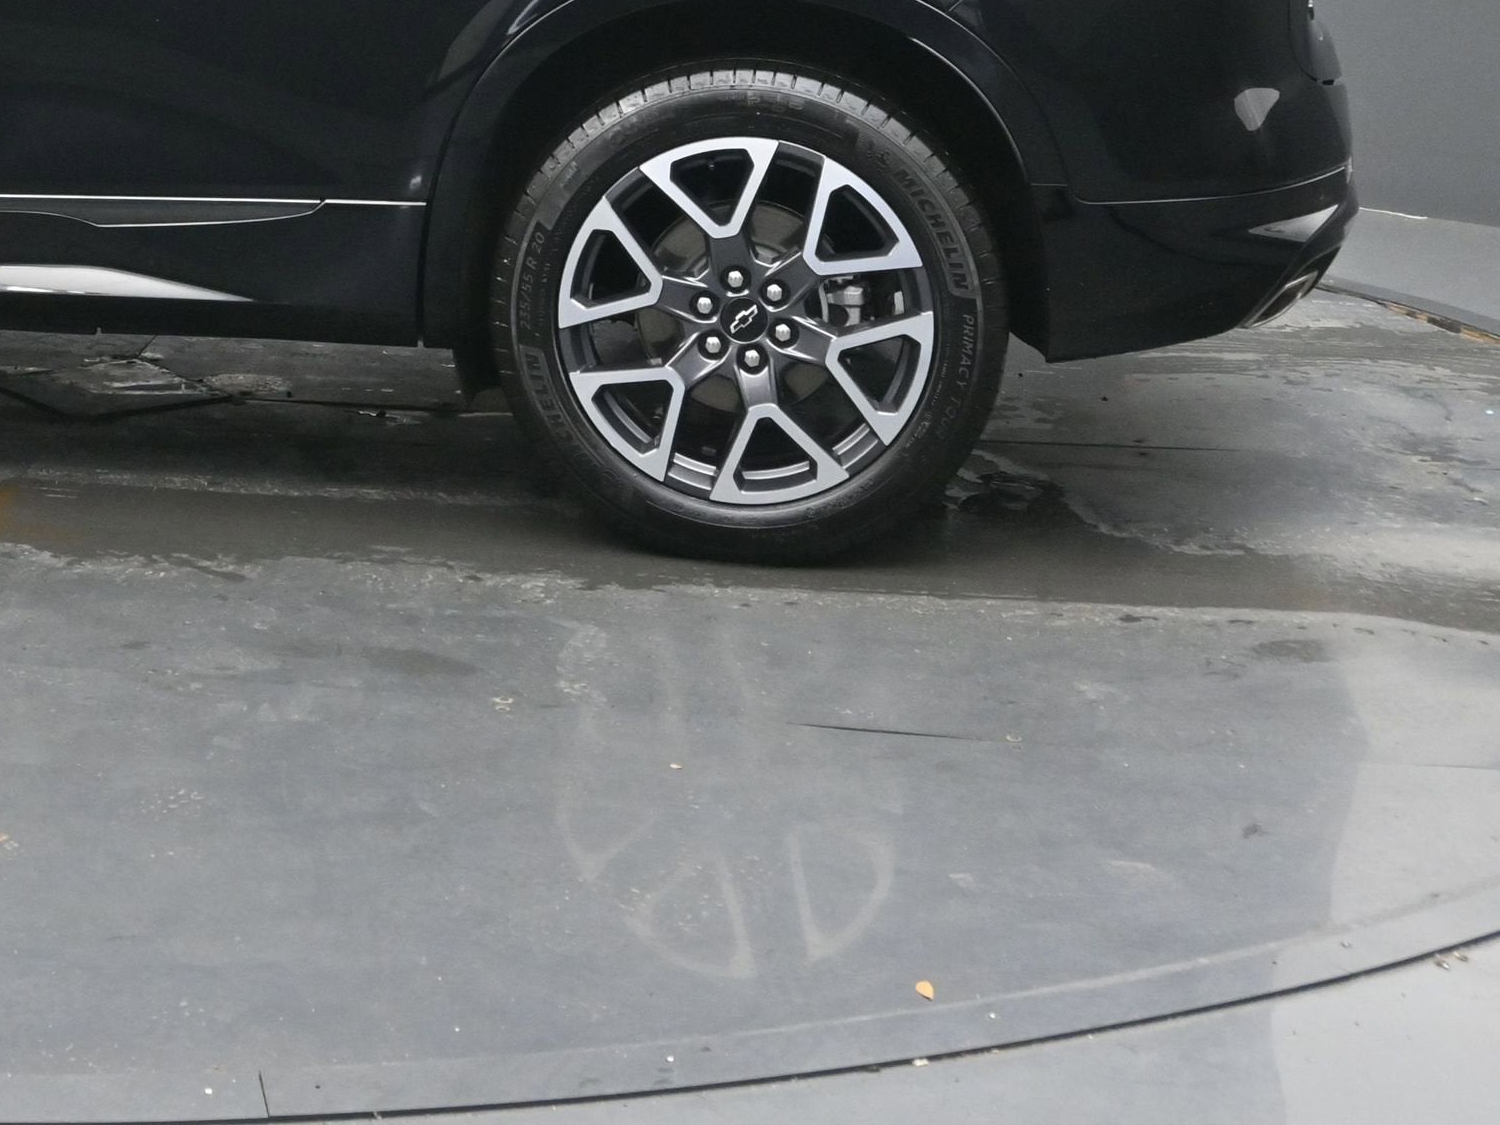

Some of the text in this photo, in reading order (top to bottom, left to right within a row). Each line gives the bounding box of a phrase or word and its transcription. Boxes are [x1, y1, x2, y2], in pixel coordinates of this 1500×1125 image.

[895, 169, 970, 290] MICHELIN
[520, 274, 534, 330] 235/55
[531, 231, 545, 254] 20
[955, 313, 975, 390] PRIMACY
